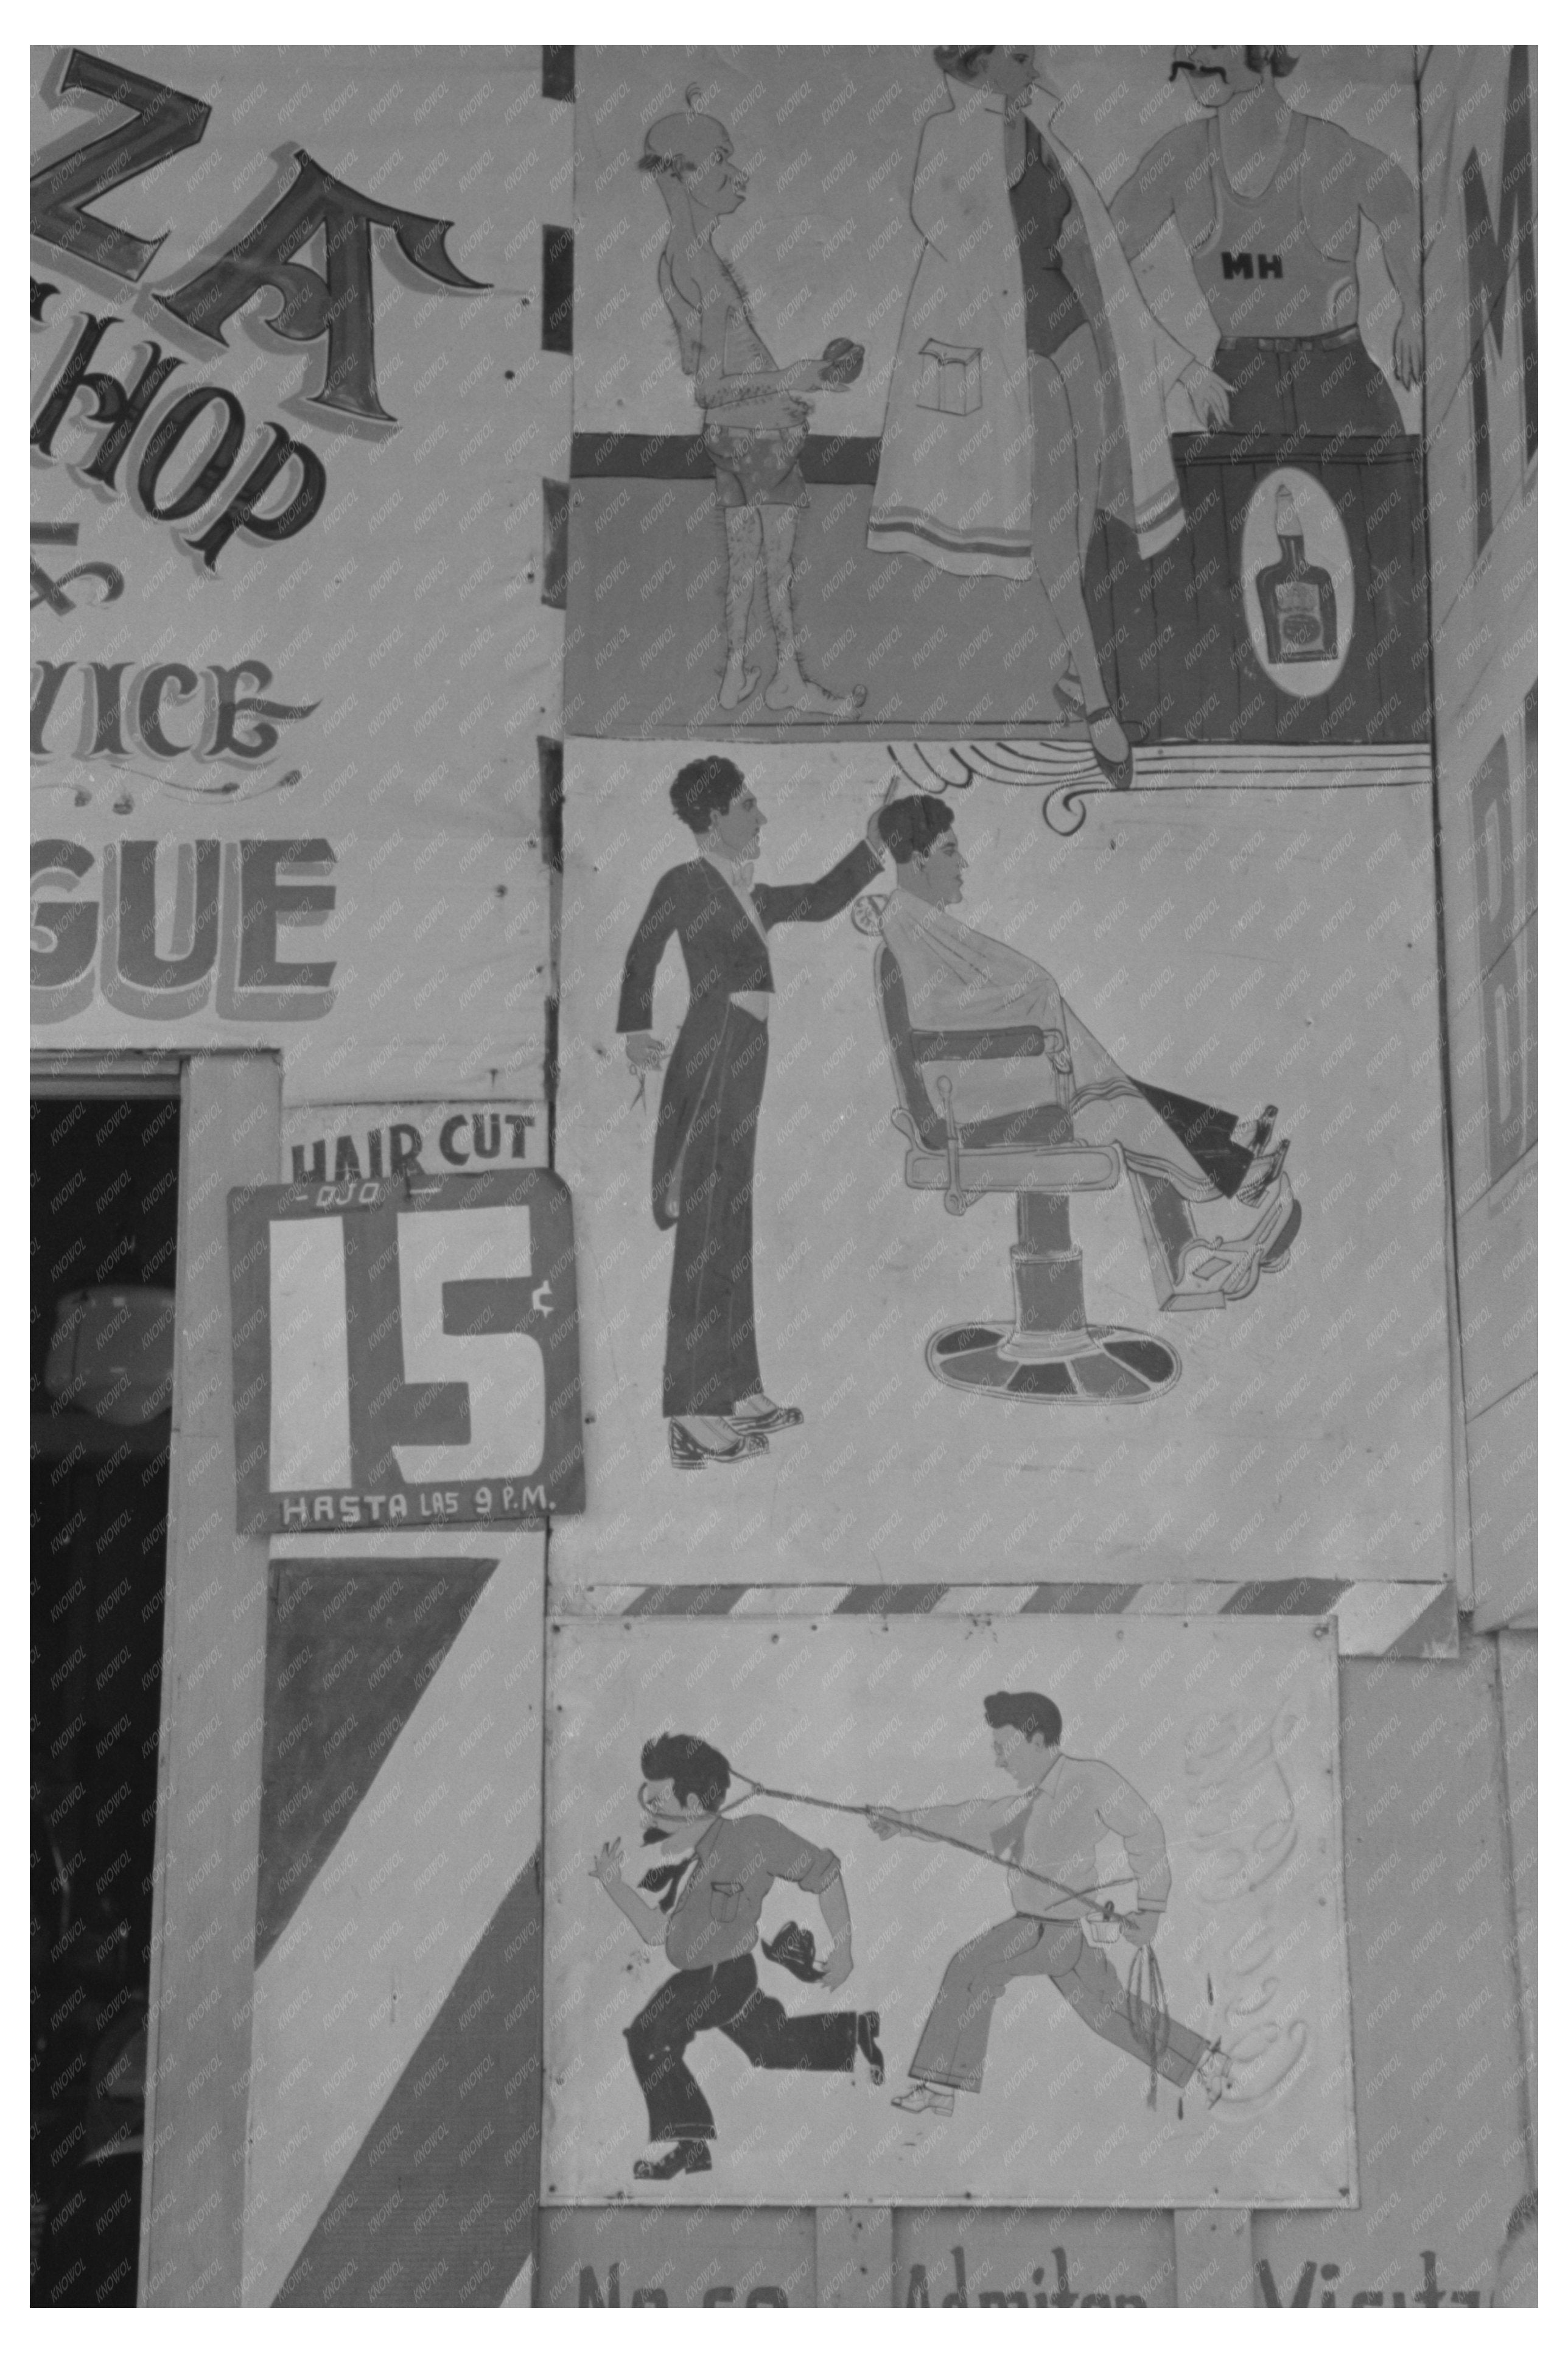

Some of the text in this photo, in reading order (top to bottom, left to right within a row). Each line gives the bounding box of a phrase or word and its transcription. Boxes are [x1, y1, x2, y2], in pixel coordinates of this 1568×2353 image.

[1222, 251, 1283, 280] MH
[30, 277, 327, 573] HOP
[292, 1113, 535, 1182] HAIR CUT
[282, 1493, 407, 1526] HASTA
[420, 1492, 459, 1517] LAS
[475, 1486, 492, 1514] 9
